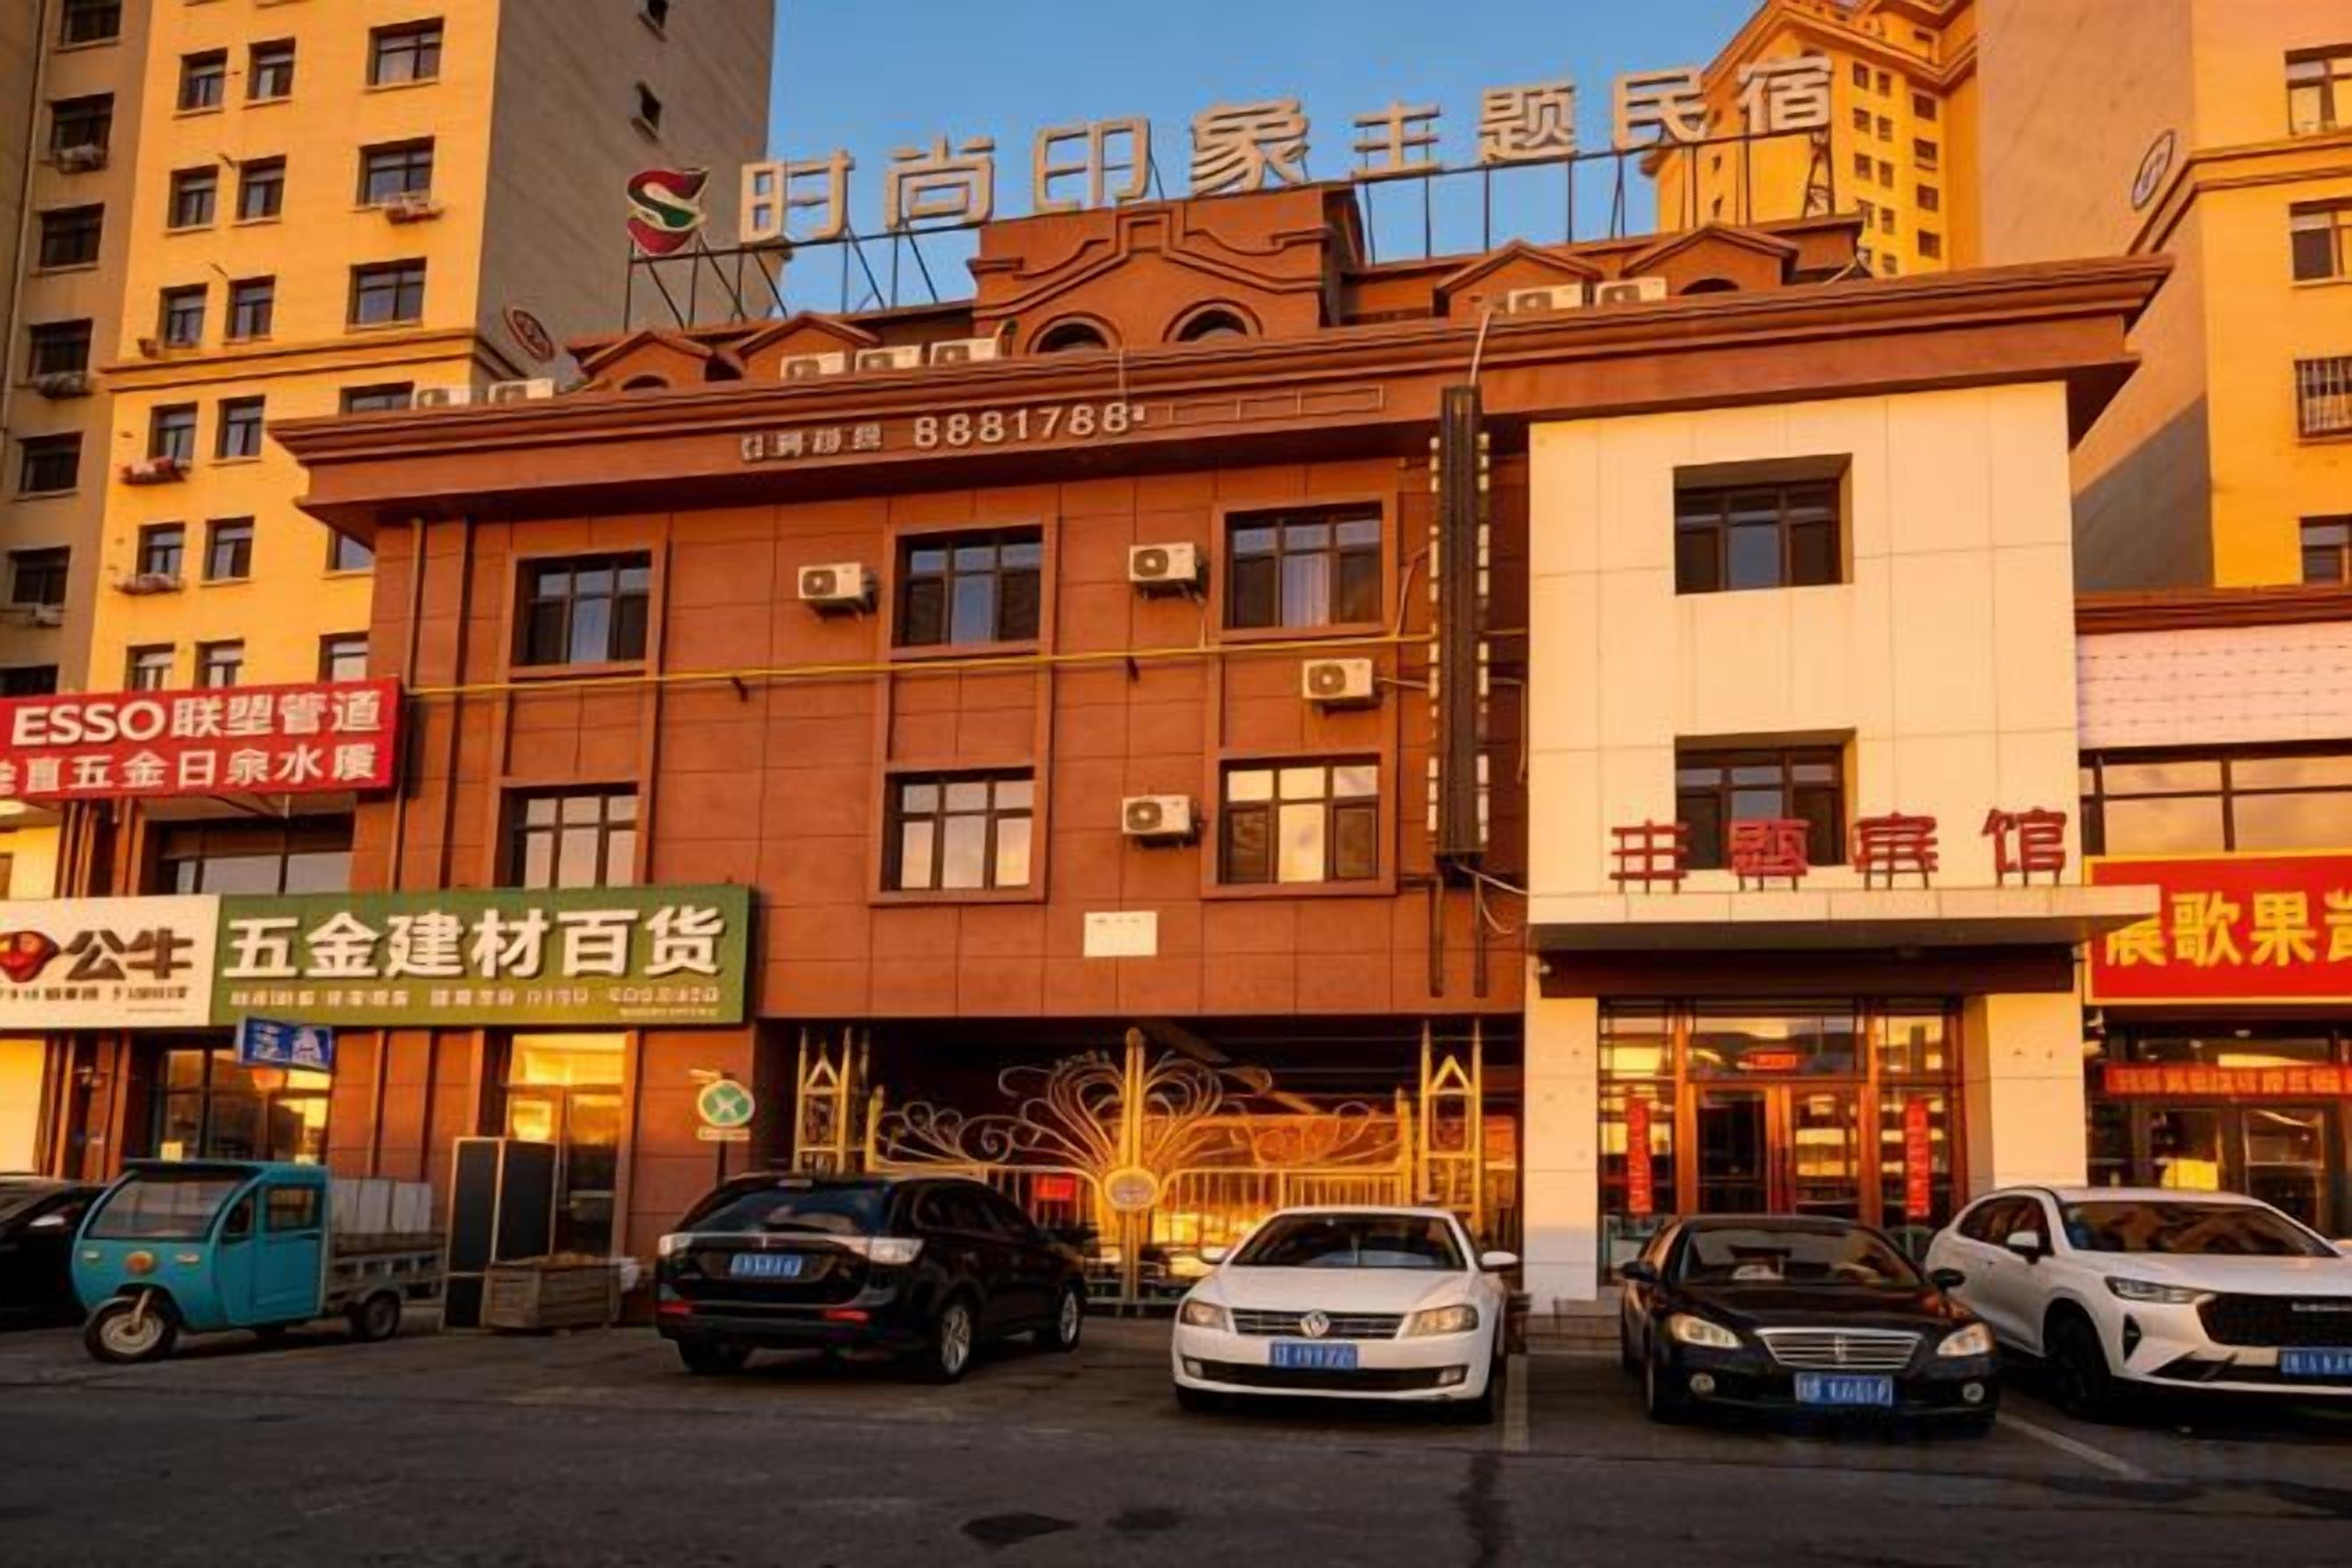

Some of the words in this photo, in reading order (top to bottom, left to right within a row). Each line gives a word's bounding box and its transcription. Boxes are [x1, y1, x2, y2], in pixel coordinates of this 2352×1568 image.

[739, 53, 1832, 244] 时尚印象主题民宿
[913, 403, 1128, 447] 8881788
[61, 927, 193, 980] 公牛
[222, 904, 726, 979] 五金建材百货
